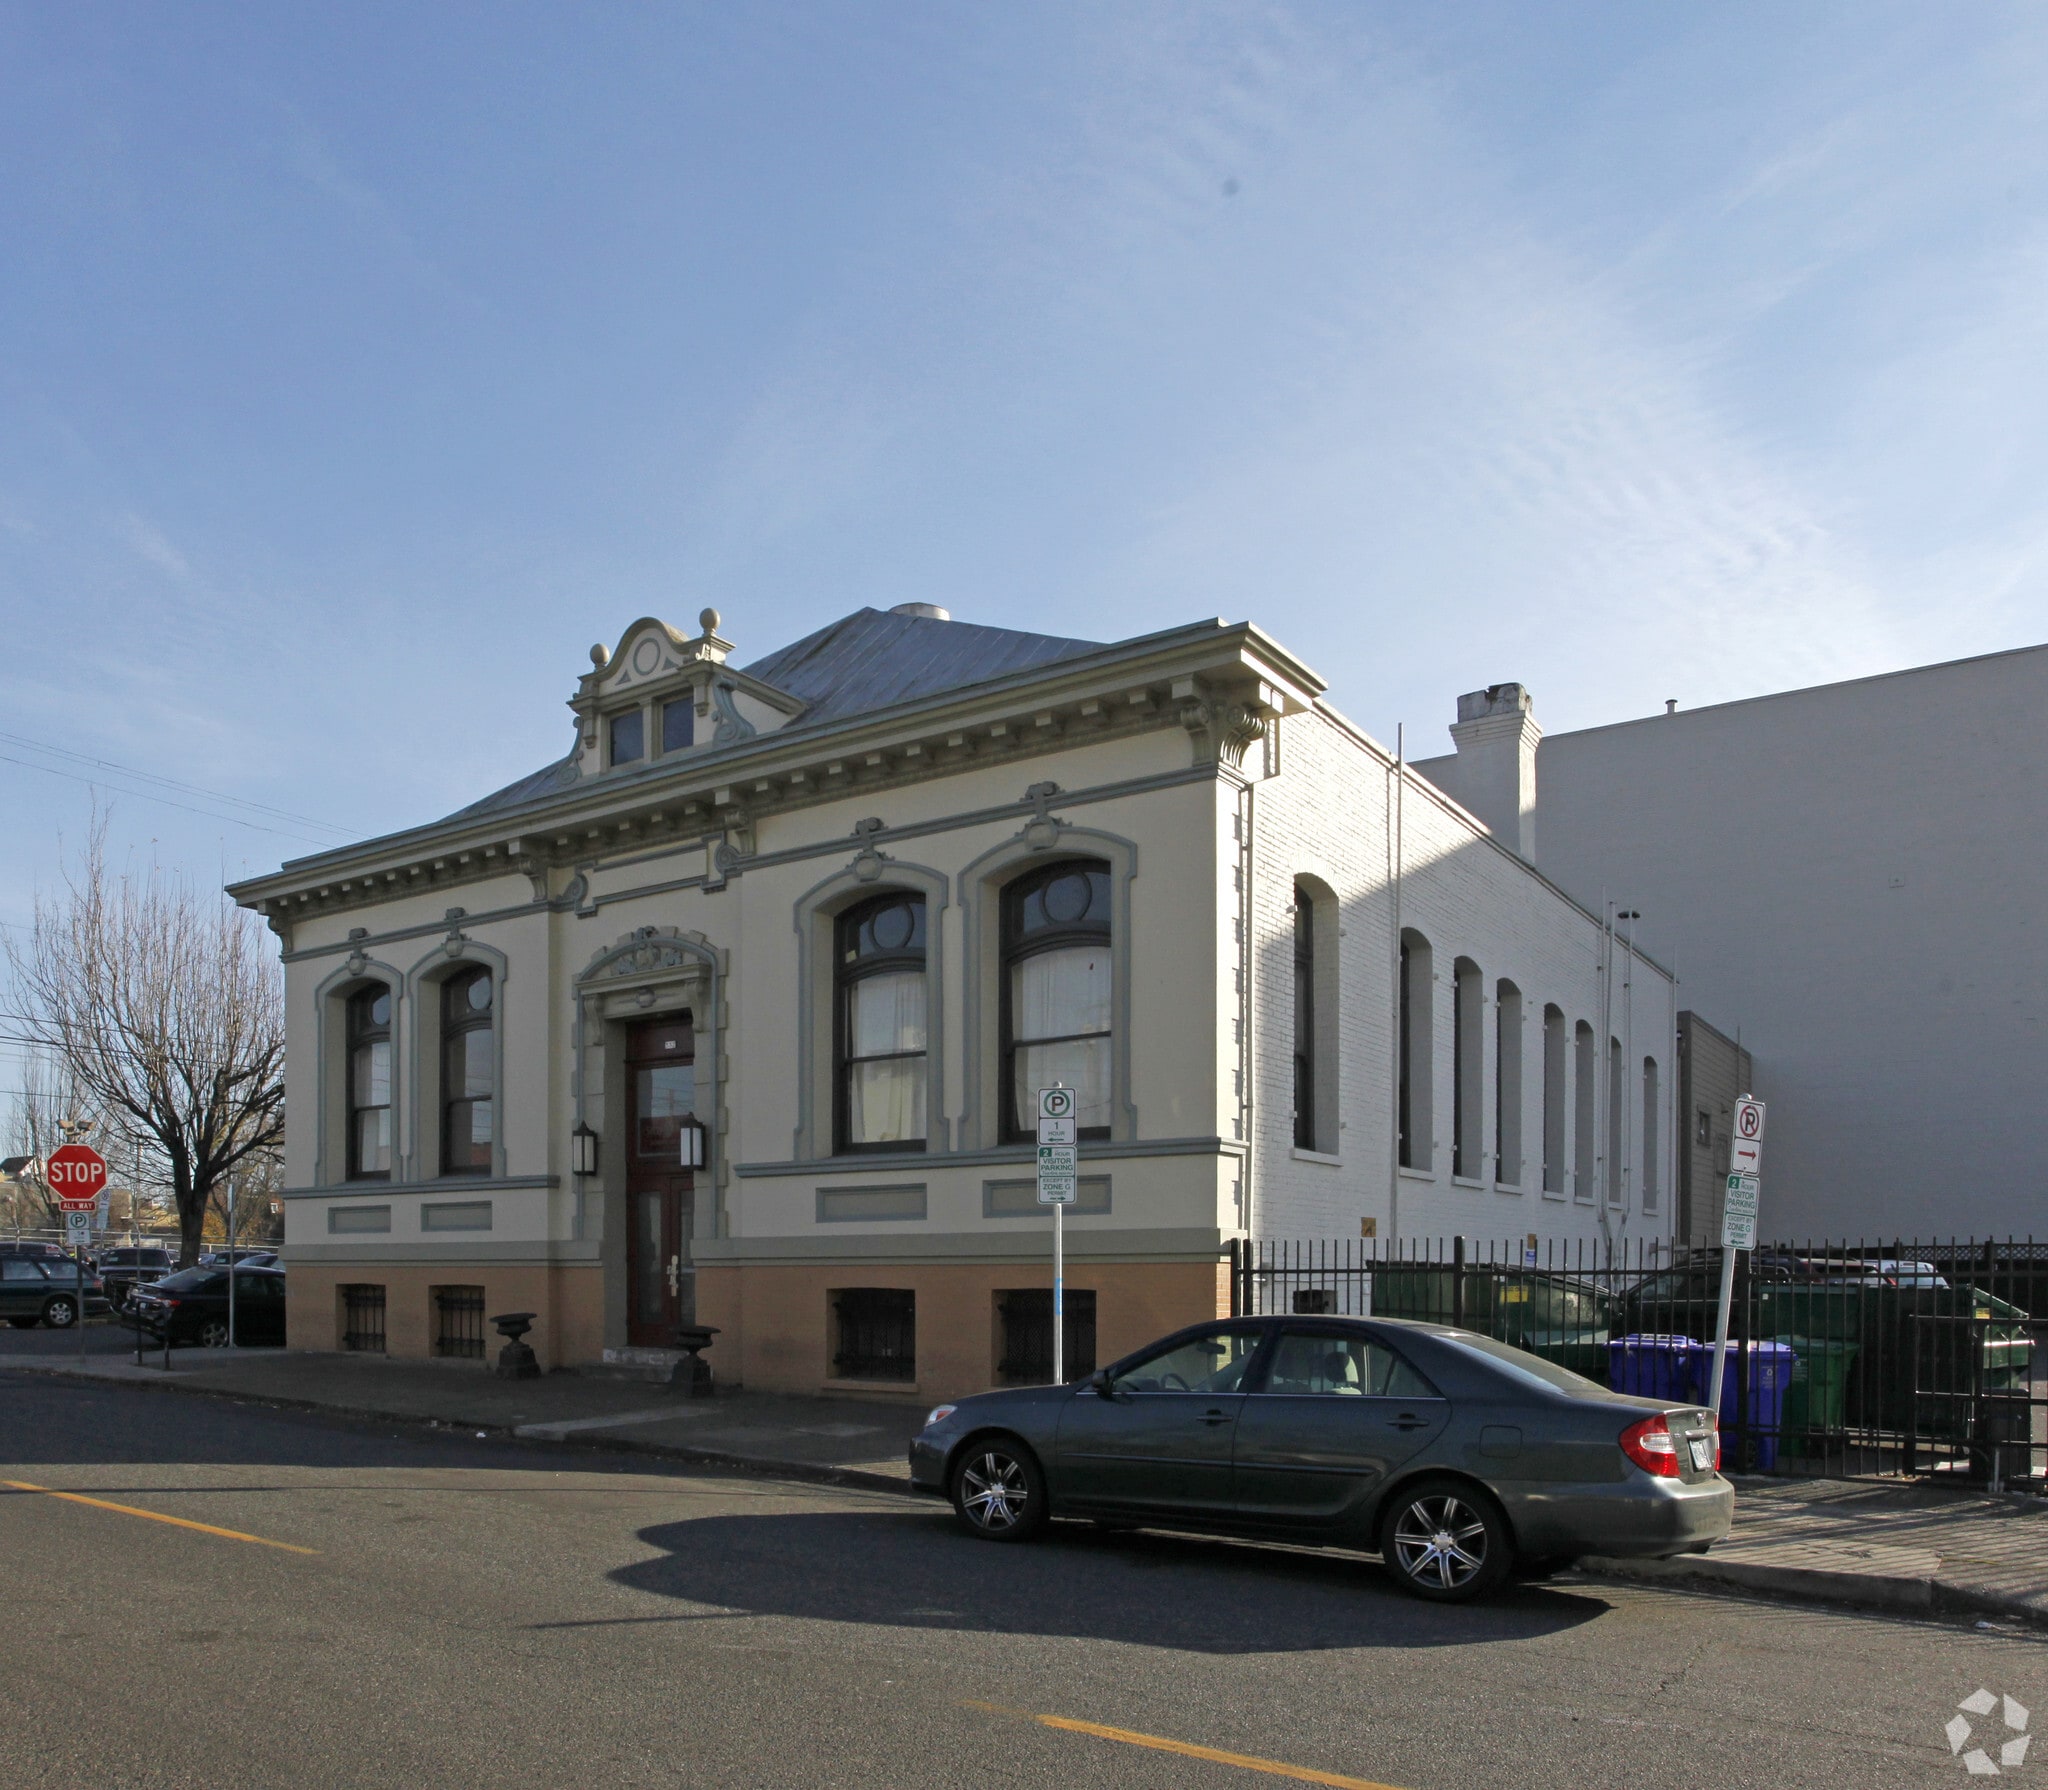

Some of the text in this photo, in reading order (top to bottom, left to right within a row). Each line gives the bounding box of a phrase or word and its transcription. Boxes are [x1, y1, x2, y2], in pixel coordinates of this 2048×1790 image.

[1052, 1096, 1065, 1111] P
[1054, 1122, 1059, 1130] 1
[51, 1162, 102, 1183] STOP
[1731, 1179, 1737, 1188] 2
[1730, 1190, 1754, 1200] VISITOR
[1728, 1198, 1757, 1209] PARKING
[1727, 1222, 1745, 1231] ZONE
